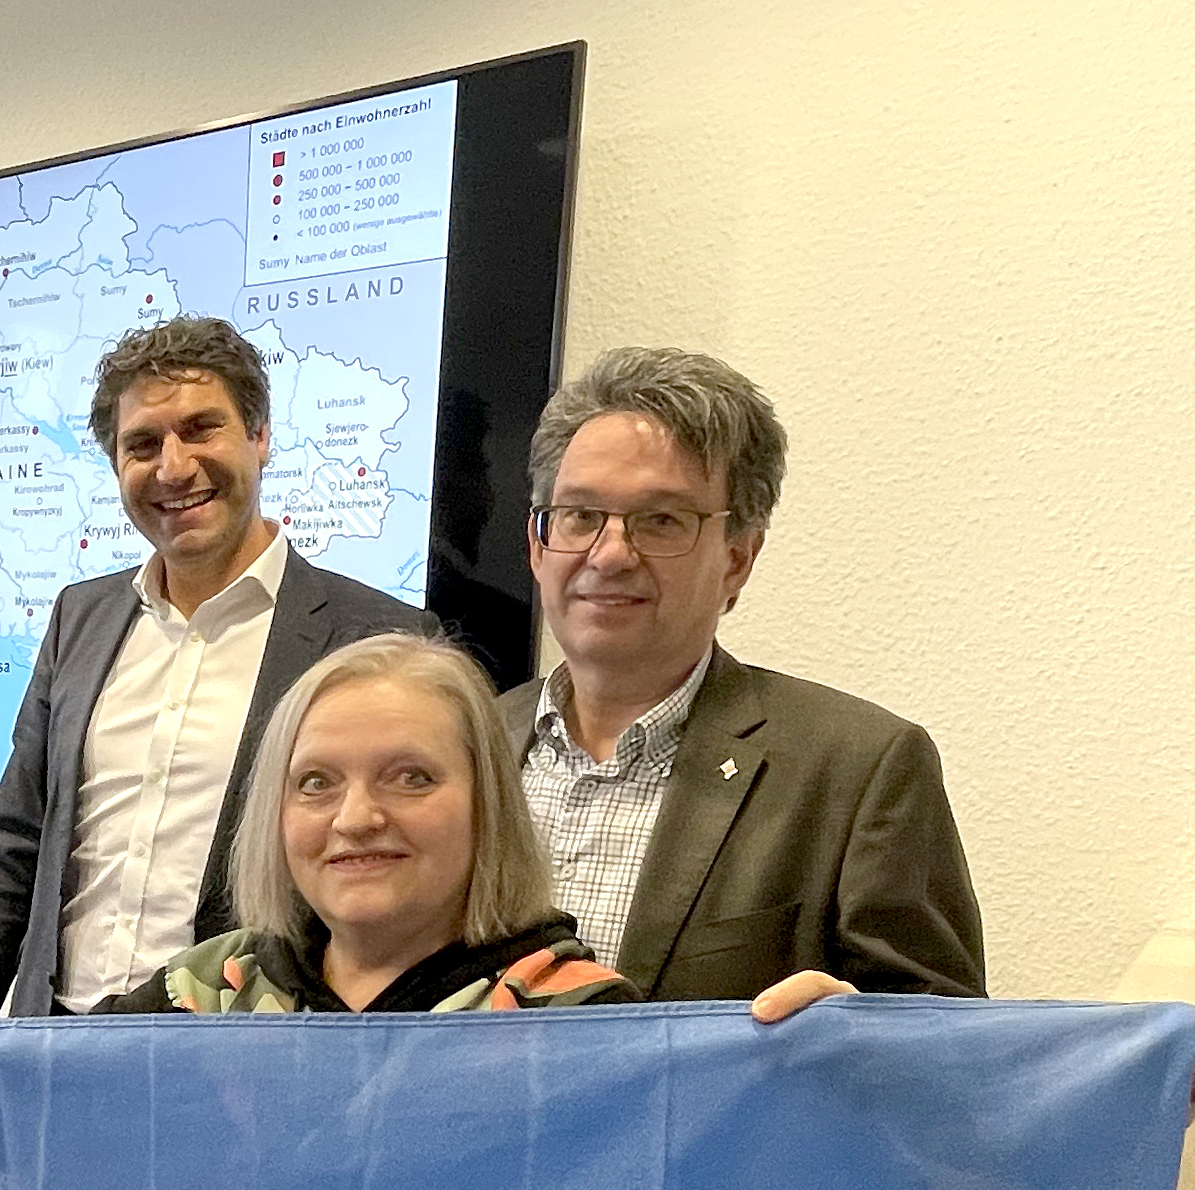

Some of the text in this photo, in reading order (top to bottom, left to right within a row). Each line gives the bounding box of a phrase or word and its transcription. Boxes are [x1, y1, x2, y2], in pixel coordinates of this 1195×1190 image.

[260, 98, 432, 144] Städte nach Einwohnerzahl
[320, 142, 341, 156] 000
[343, 137, 364, 151] 000
[299, 168, 319, 181] 500
[322, 163, 342, 177] 000
[366, 154, 387, 169] 000
[391, 150, 412, 164] 000
[298, 188, 318, 201] 250
[321, 183, 341, 197] 000
[355, 177, 376, 191] 500
[379, 172, 400, 187] 000
[298, 207, 317, 220] 100
[320, 203, 340, 217] 000
[354, 197, 374, 211] 250
[378, 193, 399, 207] 000
[308, 224, 326, 237] 100
[329, 221, 350, 234] 000
[259, 241, 387, 270] Sumy Name der Oblast
[100, 285, 127, 298] Sumy
[247, 277, 404, 314] RUSSLAND
[137, 307, 164, 320] Sumy
[21, 355, 54, 373] (Kiew)
[260, 348, 285, 366] kiw
[317, 395, 366, 410] Luhansk
[324, 436, 358, 448] donezk
[339, 479, 385, 492] Luhansk
[84, 524, 121, 540] Krywyj
